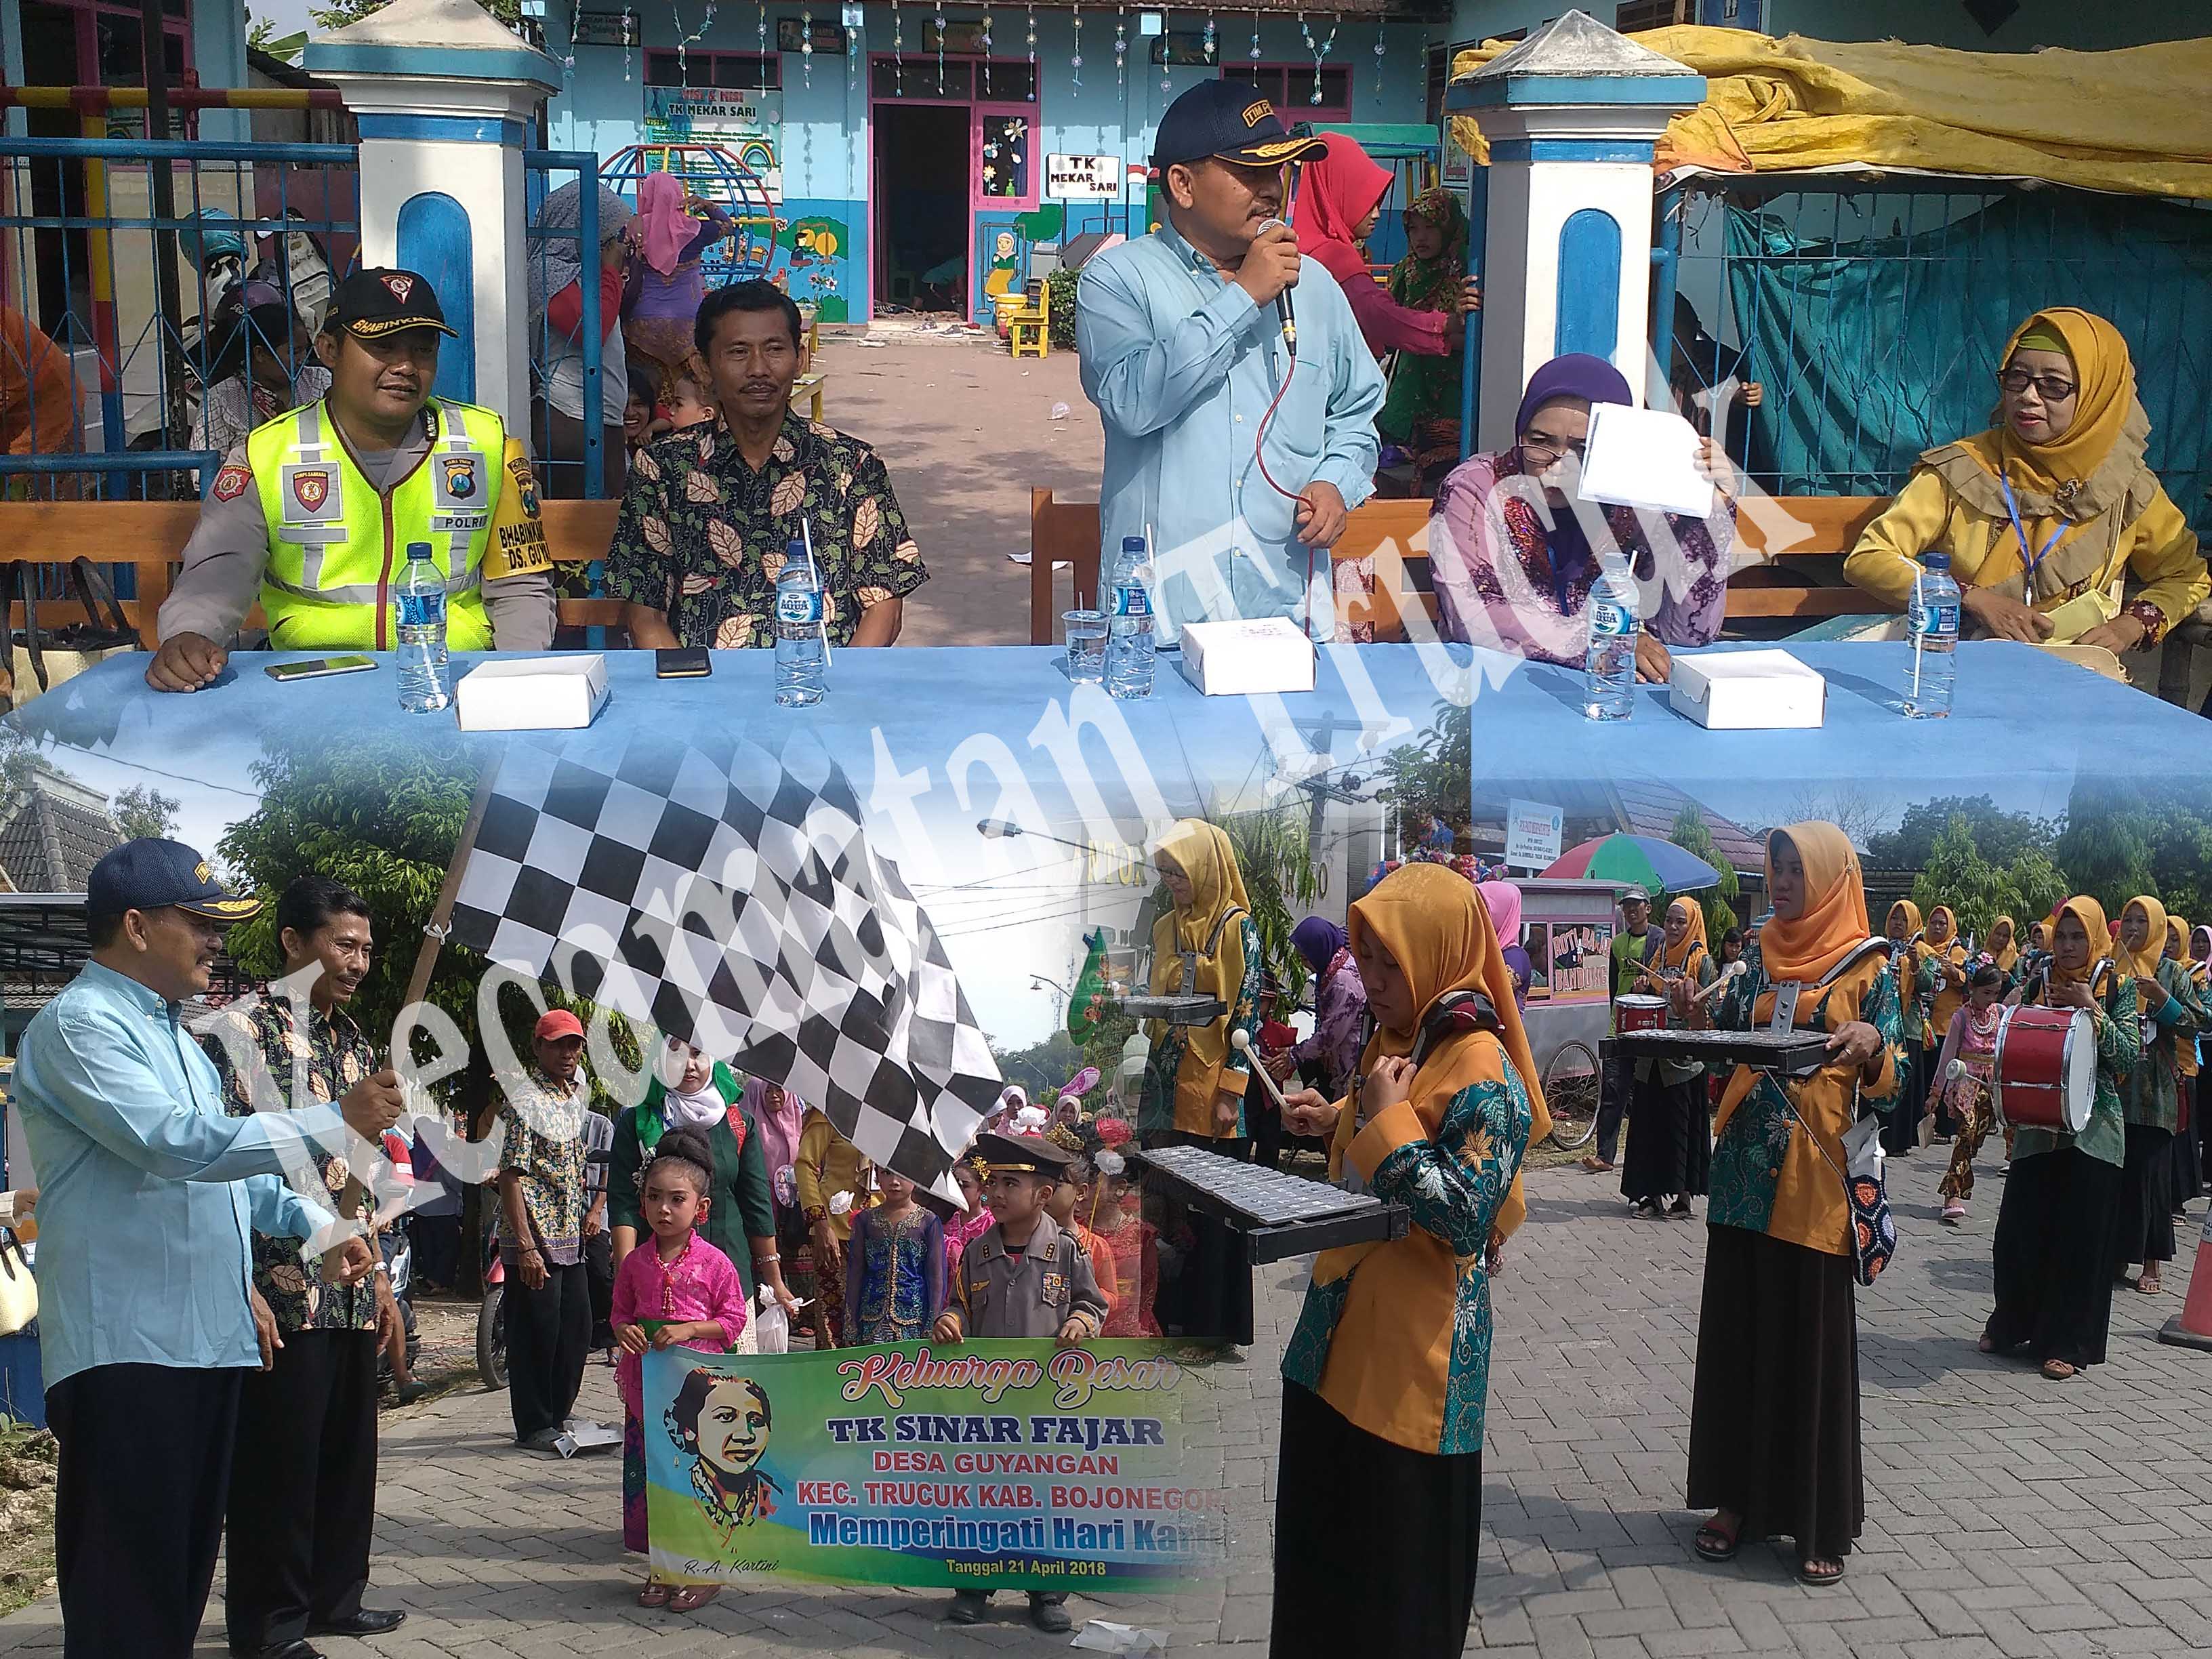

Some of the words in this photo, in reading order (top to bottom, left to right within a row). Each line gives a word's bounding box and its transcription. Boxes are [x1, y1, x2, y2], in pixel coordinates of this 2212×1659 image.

[669, 104, 684, 114] TK
[688, 105, 726, 116] MEKAR
[730, 106, 756, 117] SARI
[1069, 157, 1096, 169] TK
[1051, 173, 1094, 182] MEKAR
[1090, 182, 1117, 191] SARI
[445, 518, 483, 528] POLRI
[508, 547, 527, 570] DS.
[781, 599, 809, 612] AQUA
[1552, 927, 1578, 959] ROTI
[1555, 965, 1607, 991] BANDUNG
[836, 1346, 1044, 1409] Keluarga
[1048, 1348, 1183, 1410] Besar
[827, 1416, 888, 1443] TK
[895, 1414, 1022, 1443] SINAR
[1030, 1416, 1164, 1452] FAJAR
[874, 1451, 947, 1473] DESA
[954, 1453, 1119, 1475] GUYANGAN
[798, 1481, 857, 1505] KEC.
[864, 1482, 972, 1507] TRUCUK
[979, 1484, 1042, 1509] KAB.
[809, 1511, 1046, 1554] Memperingati
[1052, 1517, 1125, 1551] Hari
[684, 1559, 700, 1574] R.
[702, 1559, 722, 1574] A.
[729, 1559, 780, 1574] Kartini
[946, 1559, 1003, 1576] Tanggal
[1008, 1559, 1025, 1573] 21
[1030, 1561, 1065, 1577] April
[1069, 1561, 1106, 1576] 2018
